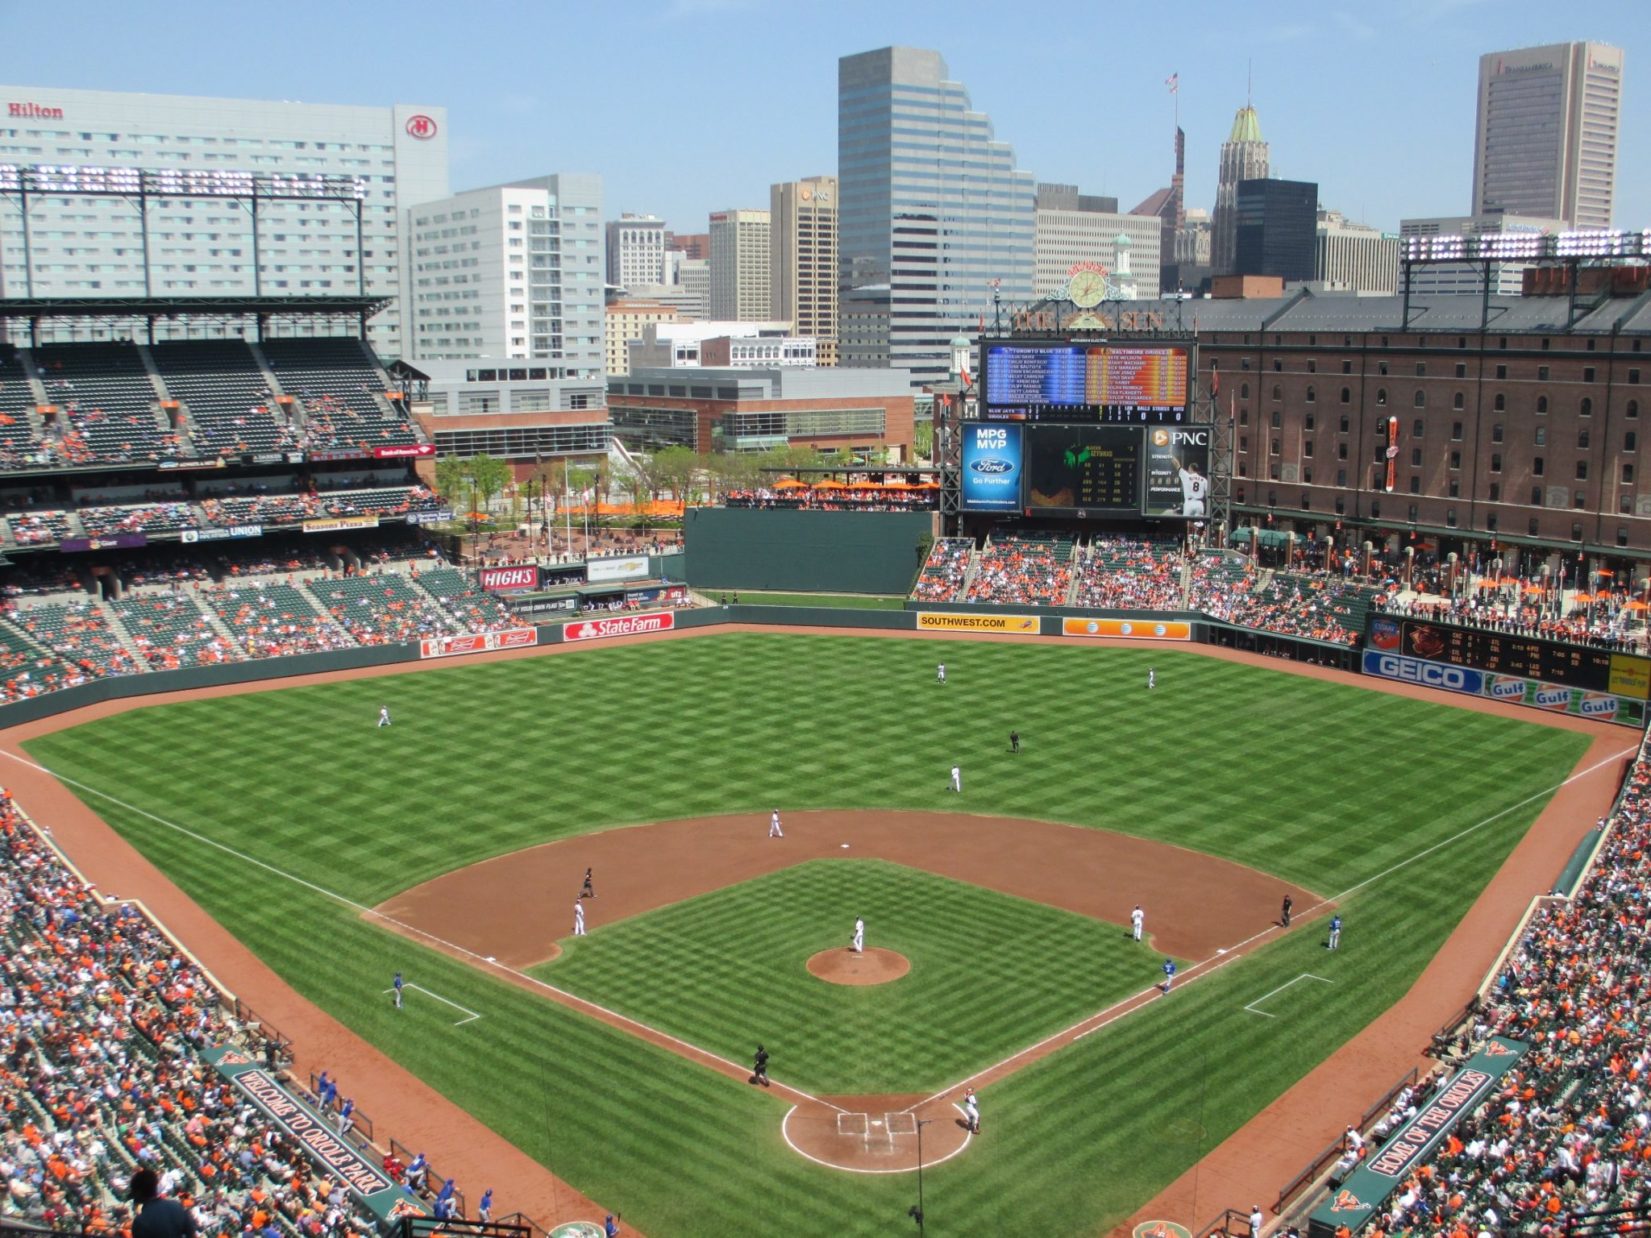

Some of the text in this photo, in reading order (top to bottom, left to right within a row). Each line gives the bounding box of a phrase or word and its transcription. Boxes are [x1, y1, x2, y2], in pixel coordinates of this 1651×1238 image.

[8, 102, 64, 119] Hilton
[1014, 312, 1164, 330] THE SUN
[977, 429, 1006, 439] MPG
[1172, 432, 1207, 446] PNC
[977, 440, 1006, 449] MVP
[977, 460, 1005, 472] Ford
[1193, 482, 1199, 492] 8
[230, 526, 262, 536] UNION
[306, 522, 338, 530] Seasons
[485, 569, 532, 586] HIGH'S
[921, 617, 1005, 627] SOUTHWEST.COM
[1380, 656, 1464, 688] GEICO
[1493, 682, 1524, 697] Gulf
[1536, 692, 1568, 704] Gulf
[1582, 700, 1615, 712] Gulf
[1372, 1071, 1486, 1175] HOME OF THE ORIOLES
[239, 1071, 385, 1194] WELCOME TO ORIOLE PARK
